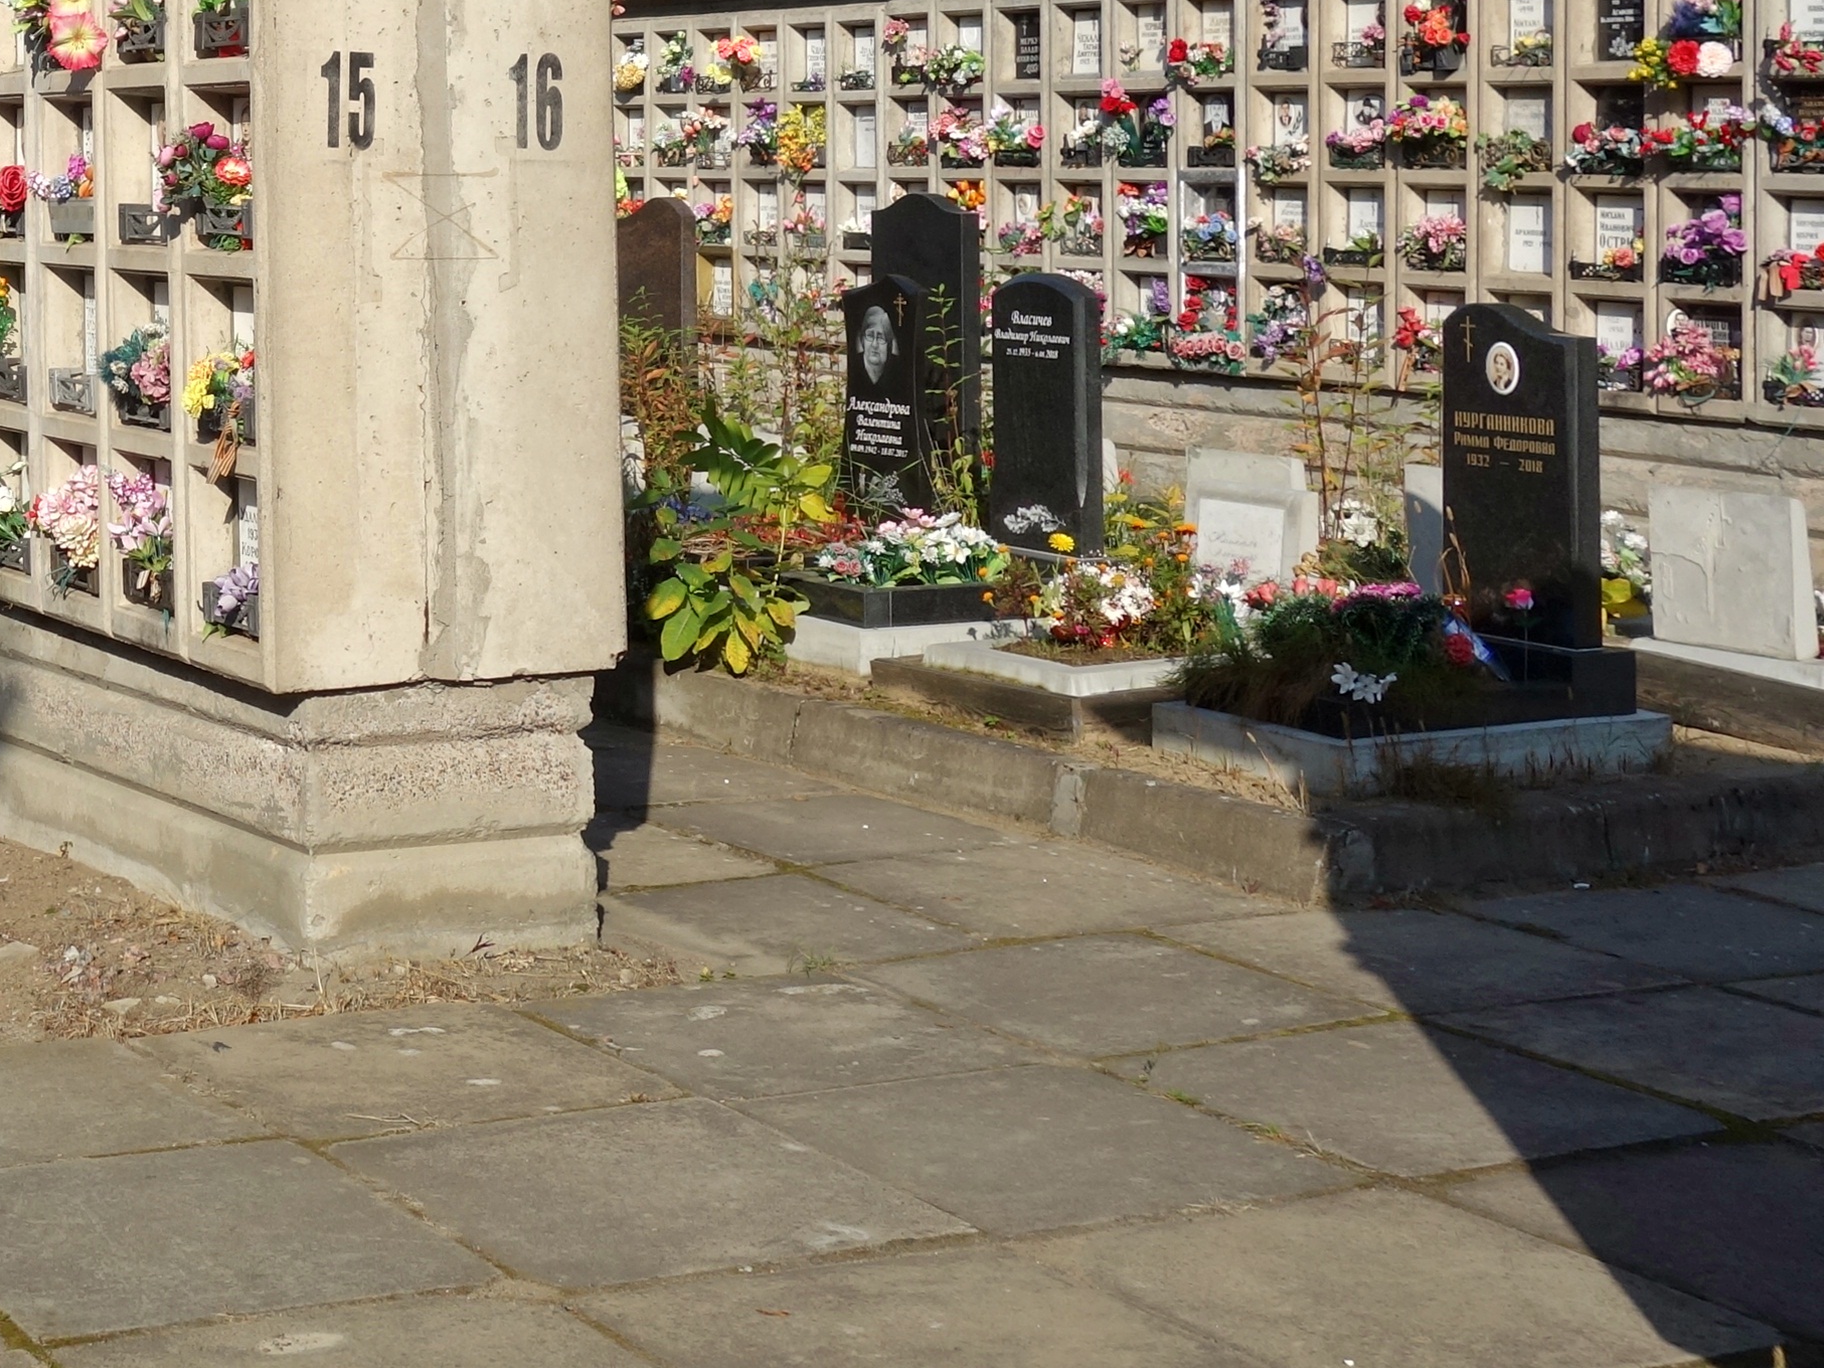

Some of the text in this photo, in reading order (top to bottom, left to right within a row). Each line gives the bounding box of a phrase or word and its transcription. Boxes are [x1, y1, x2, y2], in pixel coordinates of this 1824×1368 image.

[320, 50, 376, 151] 15
[509, 52, 564, 151] 16
[1011, 310, 1052, 326] Власичев
[994, 327, 1071, 346] Владимир Николаевич
[846, 396, 911, 418] Александрова
[856, 414, 902, 430] Валентина
[1454, 410, 1556, 437] КУРГАННИКОВА
[855, 429, 903, 445] Николаевна
[1466, 453, 1491, 468] 1932
[1518, 458, 1544, 474] 2018
